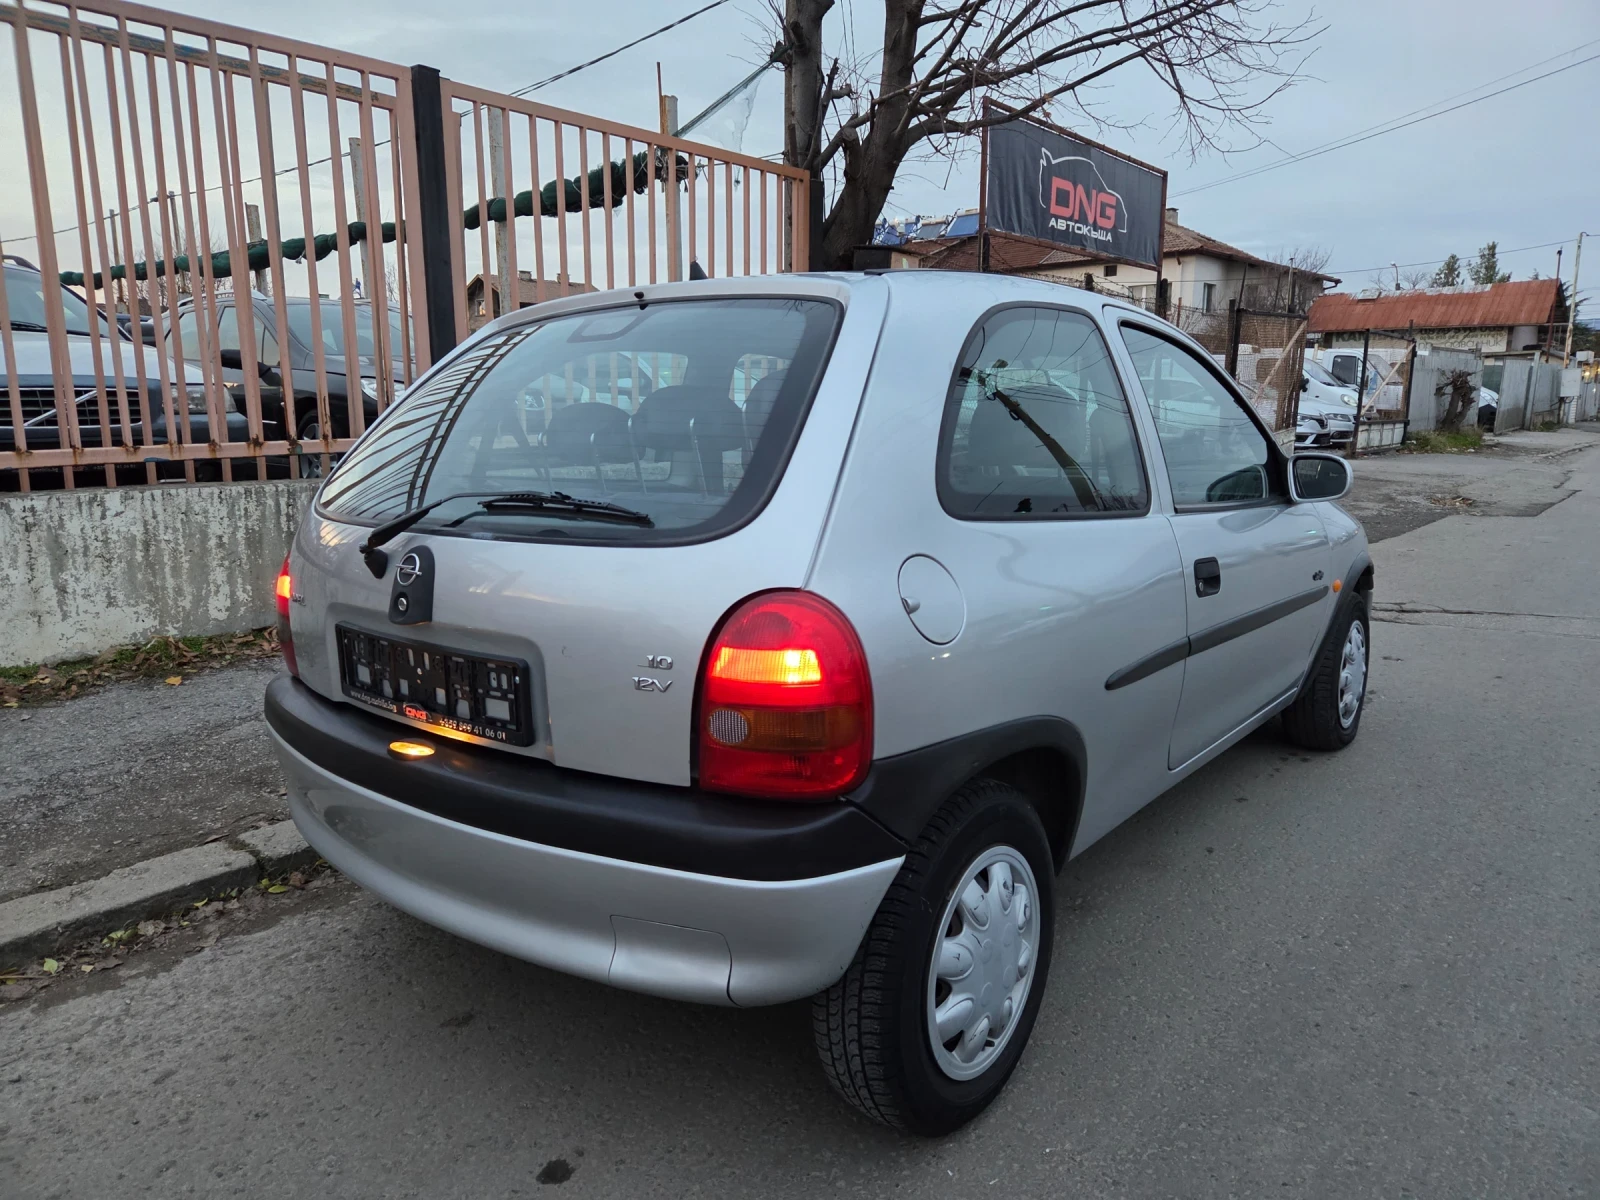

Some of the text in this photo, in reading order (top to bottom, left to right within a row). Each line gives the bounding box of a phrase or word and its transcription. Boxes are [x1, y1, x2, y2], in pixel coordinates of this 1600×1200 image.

[1050, 176, 1116, 229] DNG
[631, 676, 673, 693] 12V
[405, 706, 427, 720] DNG
[473, 725, 483, 735] 41
[485, 728, 495, 737] 06
